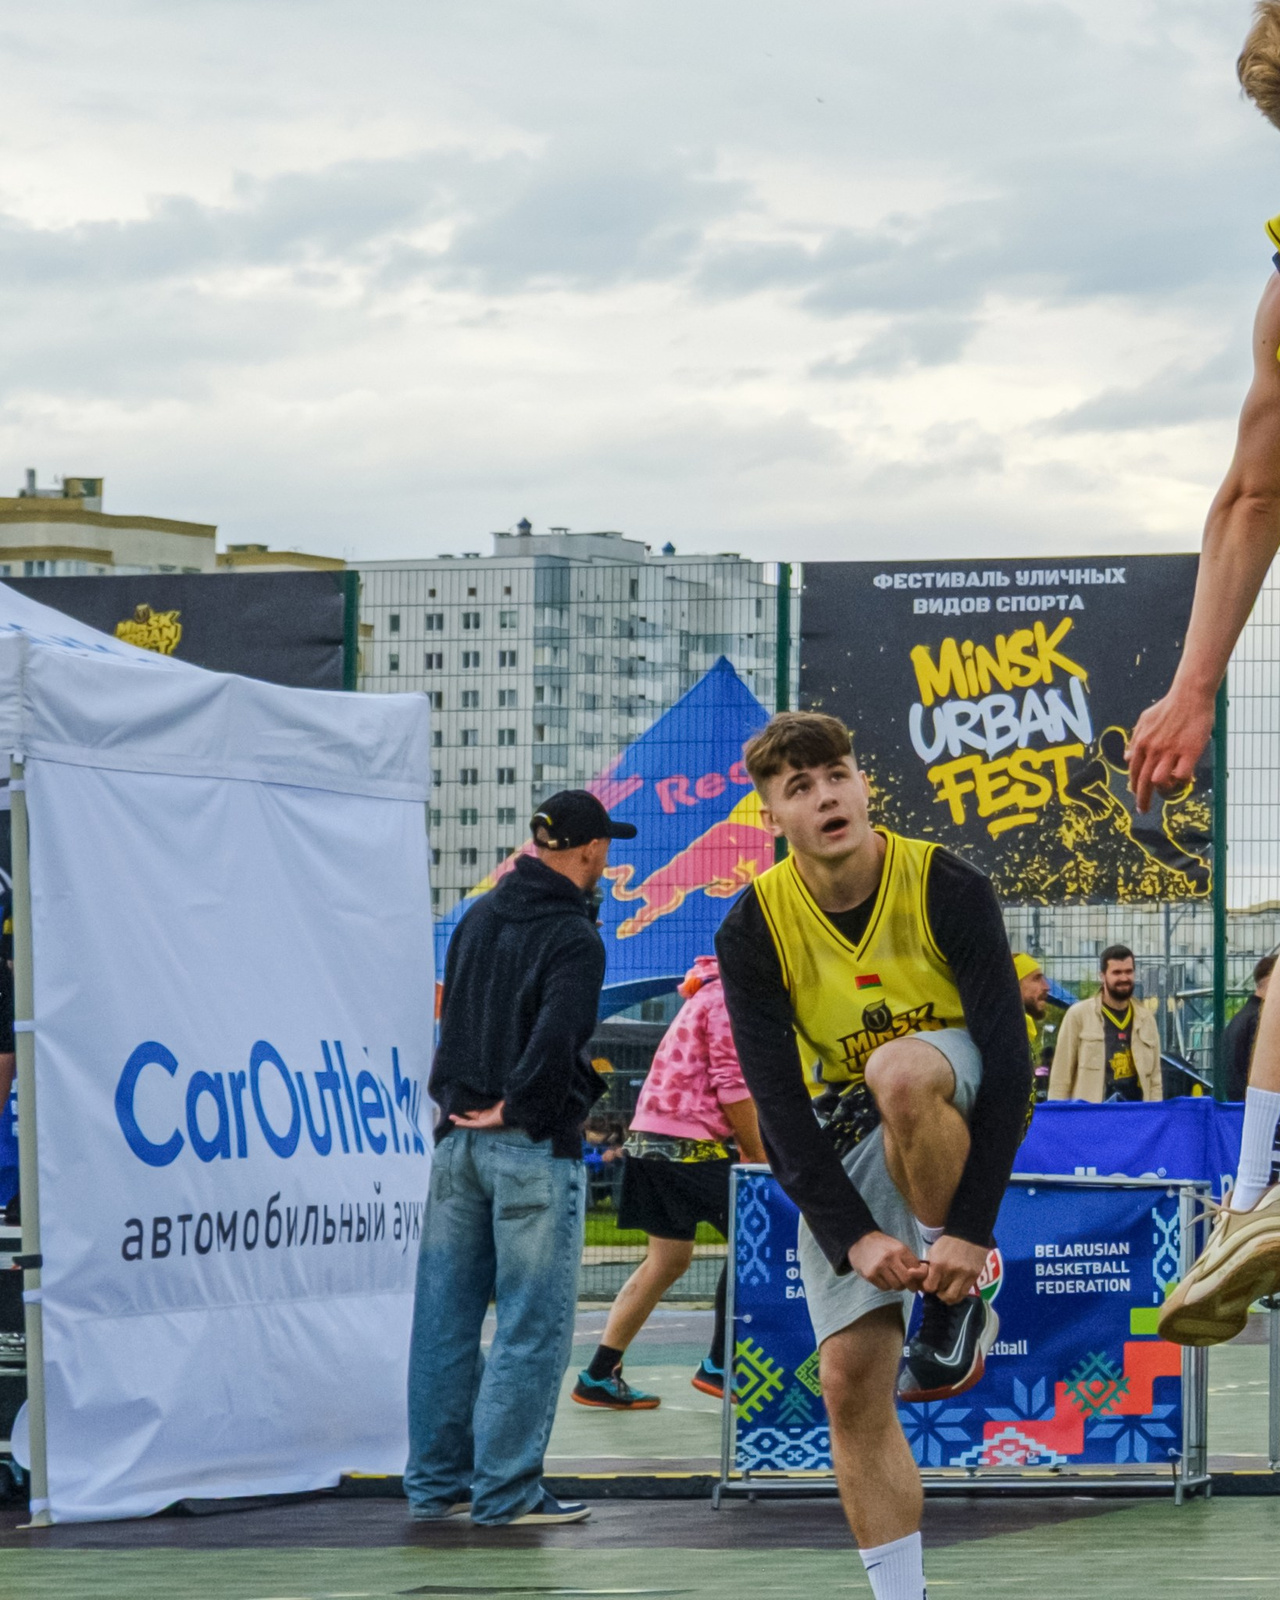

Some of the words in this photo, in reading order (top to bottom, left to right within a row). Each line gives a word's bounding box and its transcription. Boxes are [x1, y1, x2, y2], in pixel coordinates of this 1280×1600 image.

[873, 571, 1010, 589] ФЕСТИВАЛЬ
[1015, 568, 1126, 586] УЛИЧНЫХ
[913, 597, 990, 616] ВИДОВ
[996, 594, 1085, 613] СПОРТА
[909, 676, 1093, 764] URBAN
[927, 743, 1084, 825] FEST
[121, 1181, 386, 1262] автомобильный
[1034, 1242, 1130, 1259] BELARUSIAN
[1035, 1261, 1130, 1277] BASKETBALL
[1036, 1279, 1131, 1295] FEDERATION
